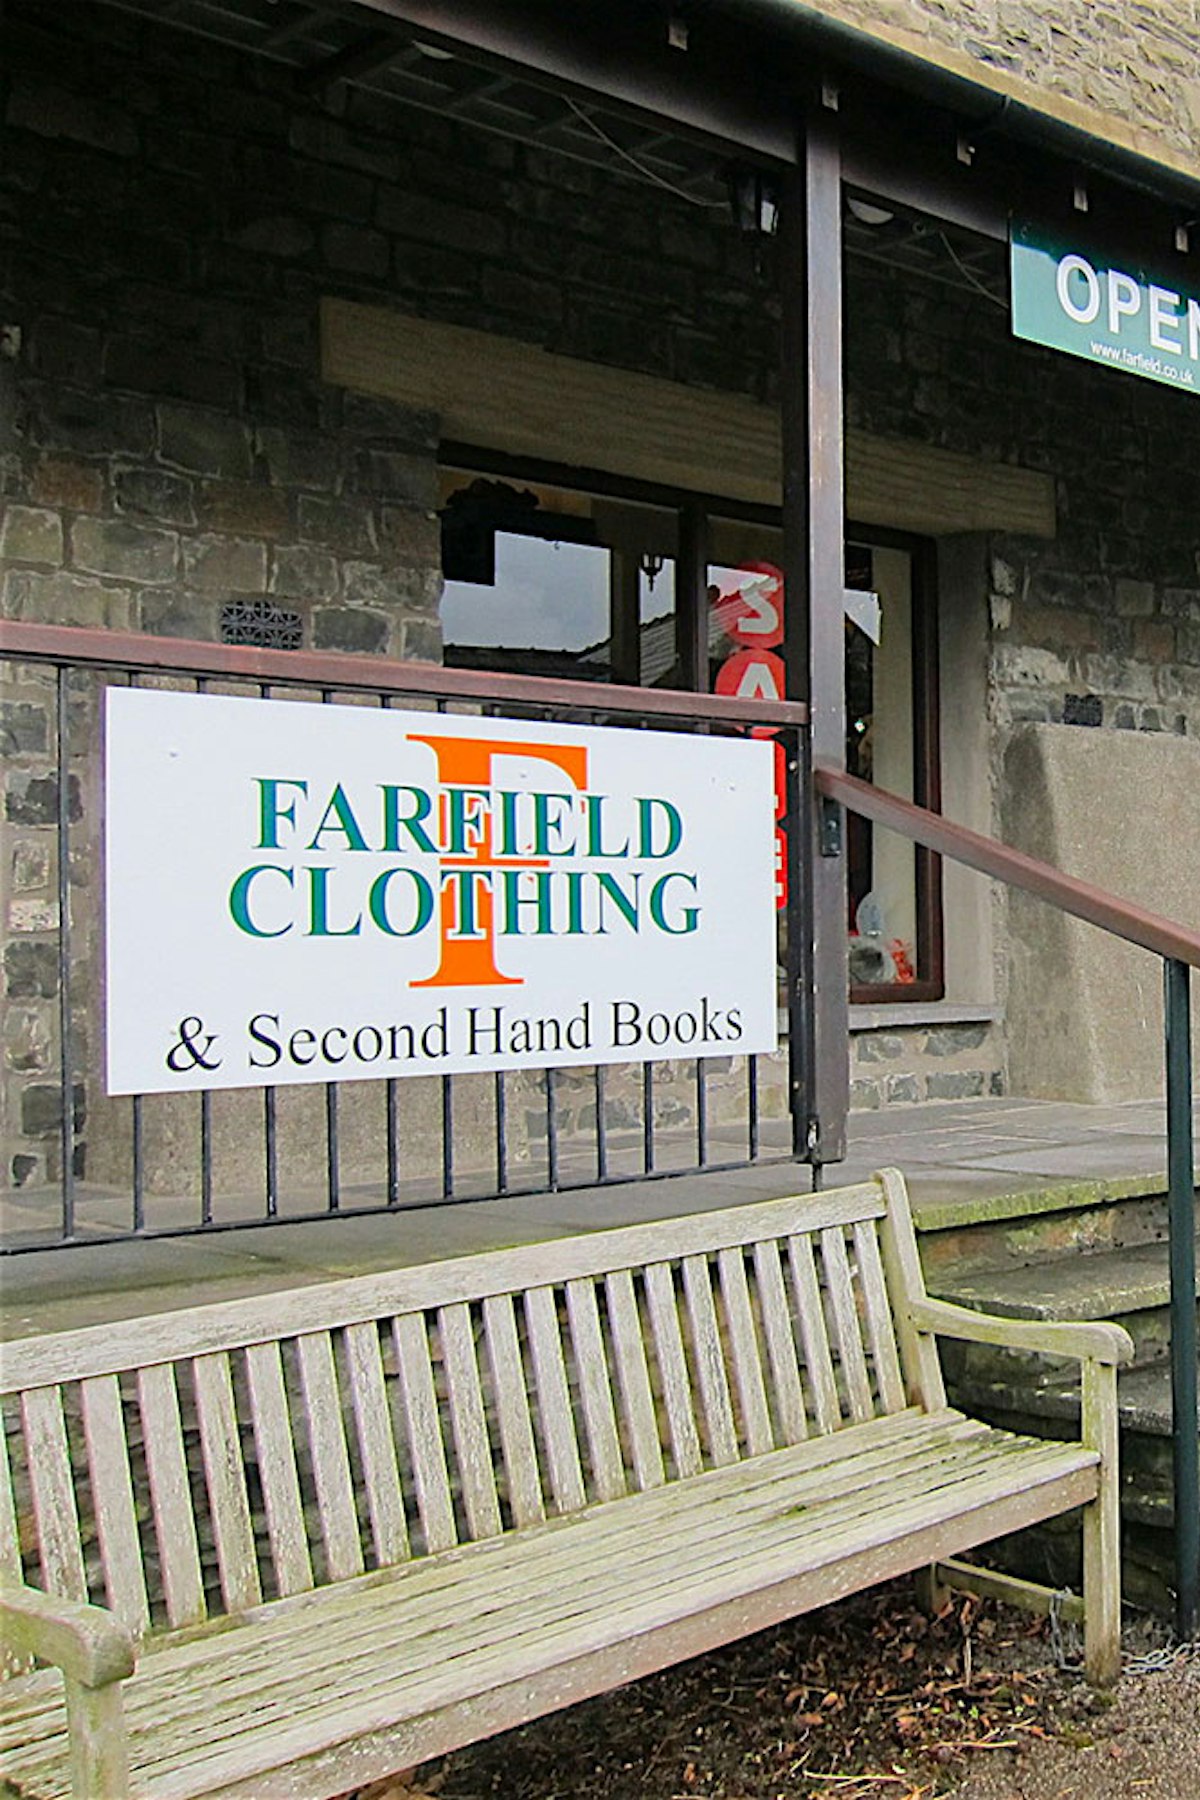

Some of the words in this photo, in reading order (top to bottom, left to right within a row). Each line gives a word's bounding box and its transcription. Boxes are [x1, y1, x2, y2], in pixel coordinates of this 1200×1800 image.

[1090, 340, 1195, 385] www.farfield.co.uk
[252, 777, 684, 859] FARFIELD
[229, 864, 702, 938] CLOTHING
[165, 1015, 223, 1072] &
[248, 1007, 449, 1068] Second
[464, 1000, 593, 1059] Hand
[610, 996, 743, 1048] Books
